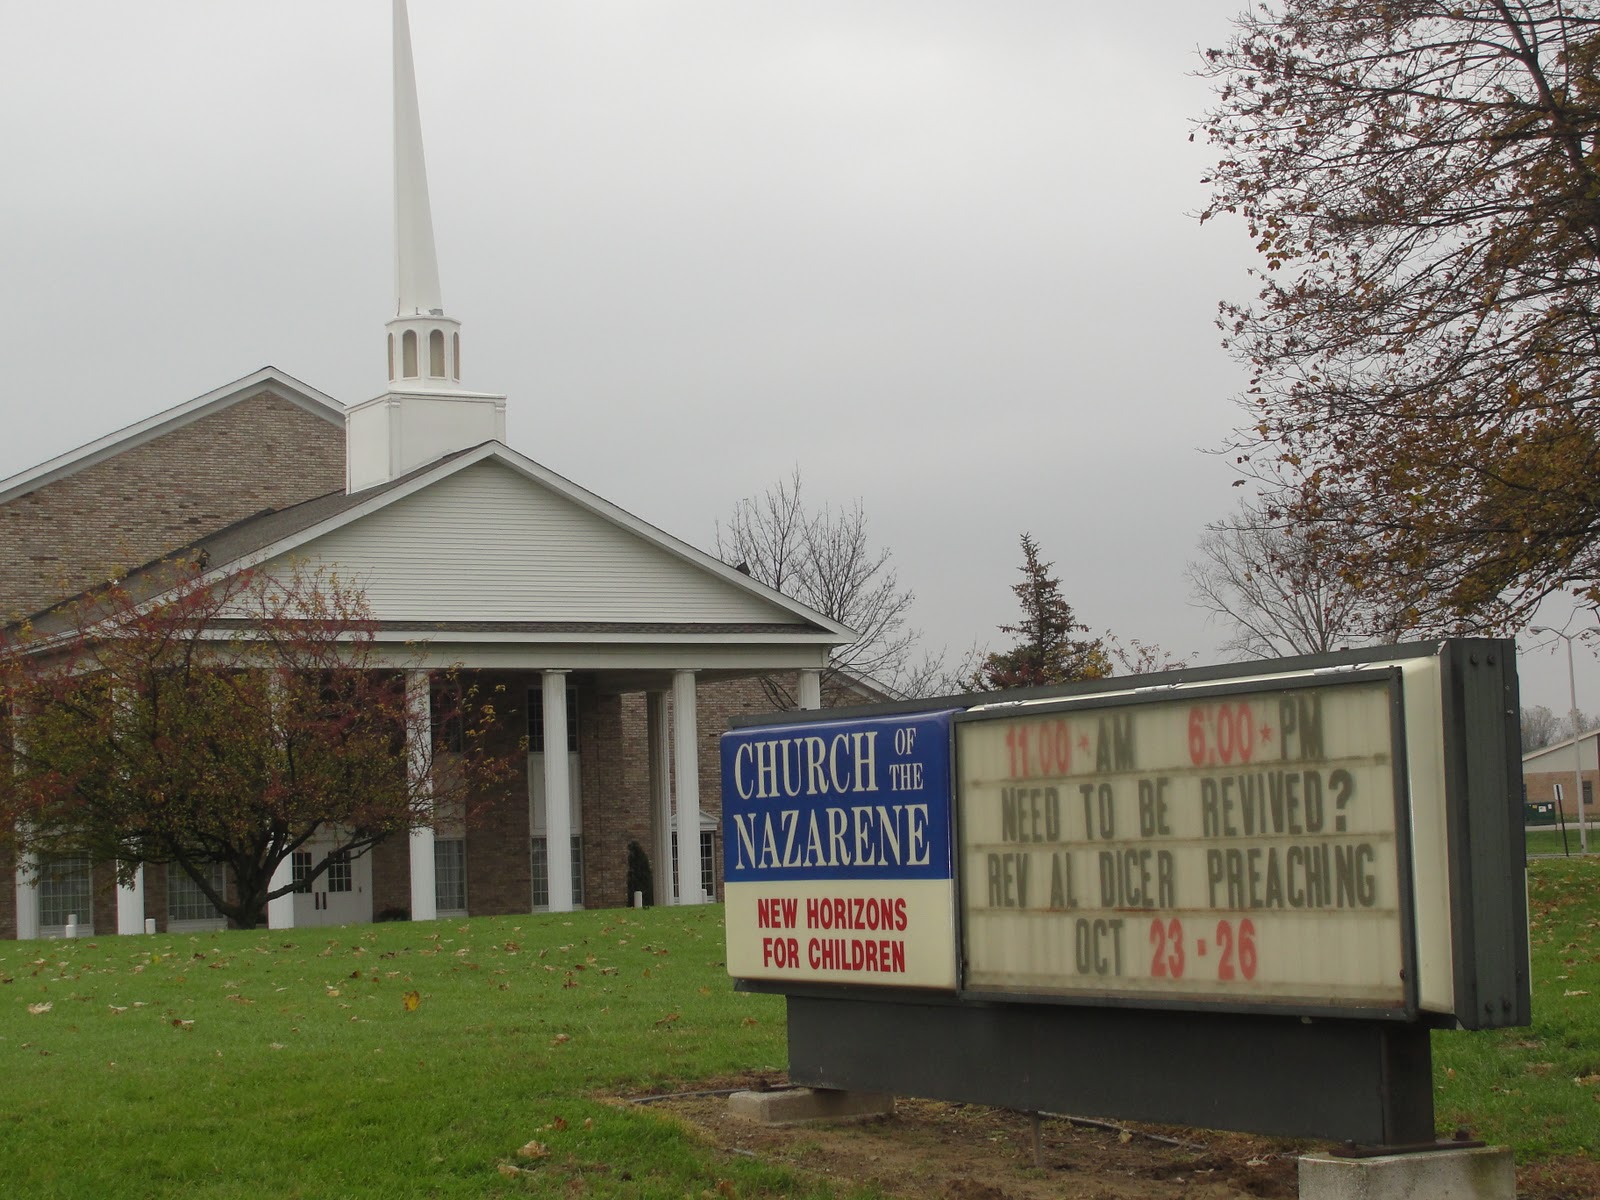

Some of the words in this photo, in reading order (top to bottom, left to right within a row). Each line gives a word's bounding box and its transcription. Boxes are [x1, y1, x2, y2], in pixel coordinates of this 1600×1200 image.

[735, 731, 878, 800] CHURCH
[894, 727, 917, 756] OF
[1096, 713, 1135, 771] AM
[1279, 697, 1325, 761] PM
[889, 763, 924, 791] THE
[1002, 787, 1060, 842] NEED
[1080, 783, 1114, 840] TO
[1139, 777, 1171, 837] BE
[1202, 769, 1354, 837] REVIVED?
[733, 804, 930, 870] NAZARENE
[988, 852, 1028, 909] REV
[1051, 852, 1078, 908] AL
[1100, 850, 1174, 908] DICER
[1207, 843, 1376, 908] PREACHING
[758, 899, 798, 928] NEW
[807, 898, 908, 931] HORIZONS
[1075, 918, 1123, 976] OCT
[763, 937, 799, 968] FOR
[808, 938, 906, 973] CHILDREN
